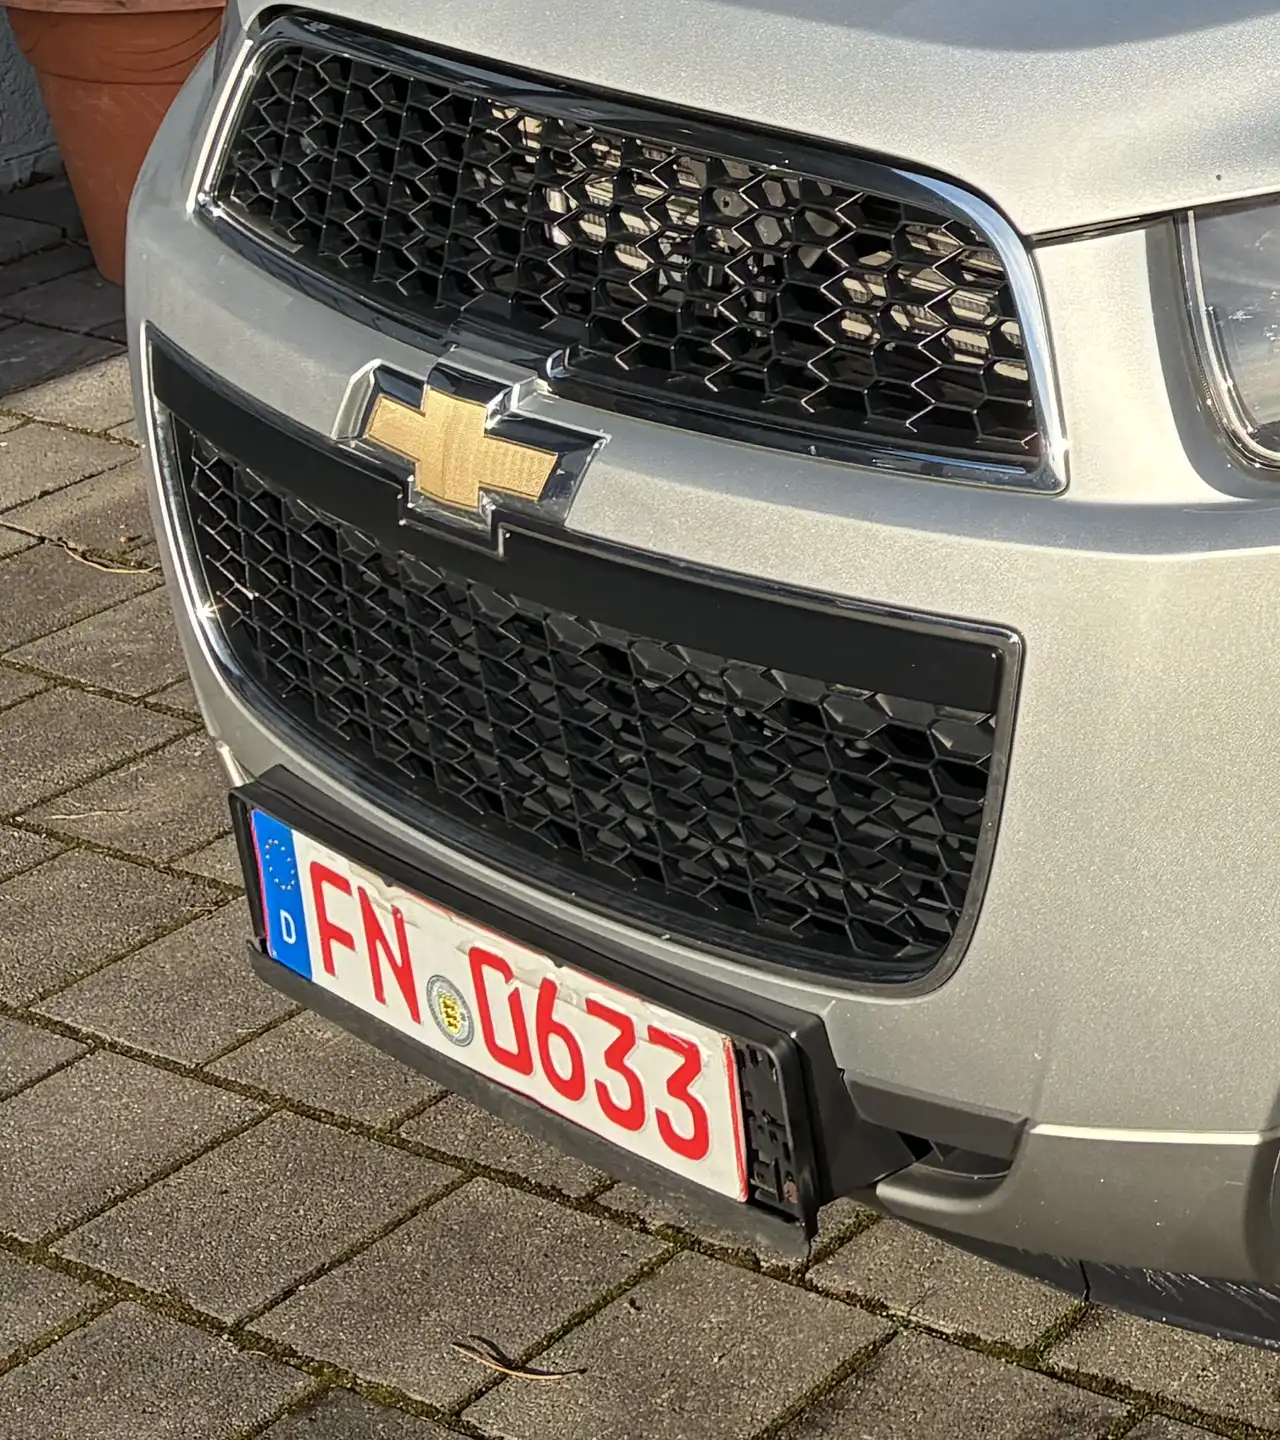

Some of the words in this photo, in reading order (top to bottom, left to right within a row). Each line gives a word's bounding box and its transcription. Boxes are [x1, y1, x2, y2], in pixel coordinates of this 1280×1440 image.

[279, 910, 297, 945] D
[309, 861, 421, 1025] FN
[469, 946, 710, 1161] 0633
